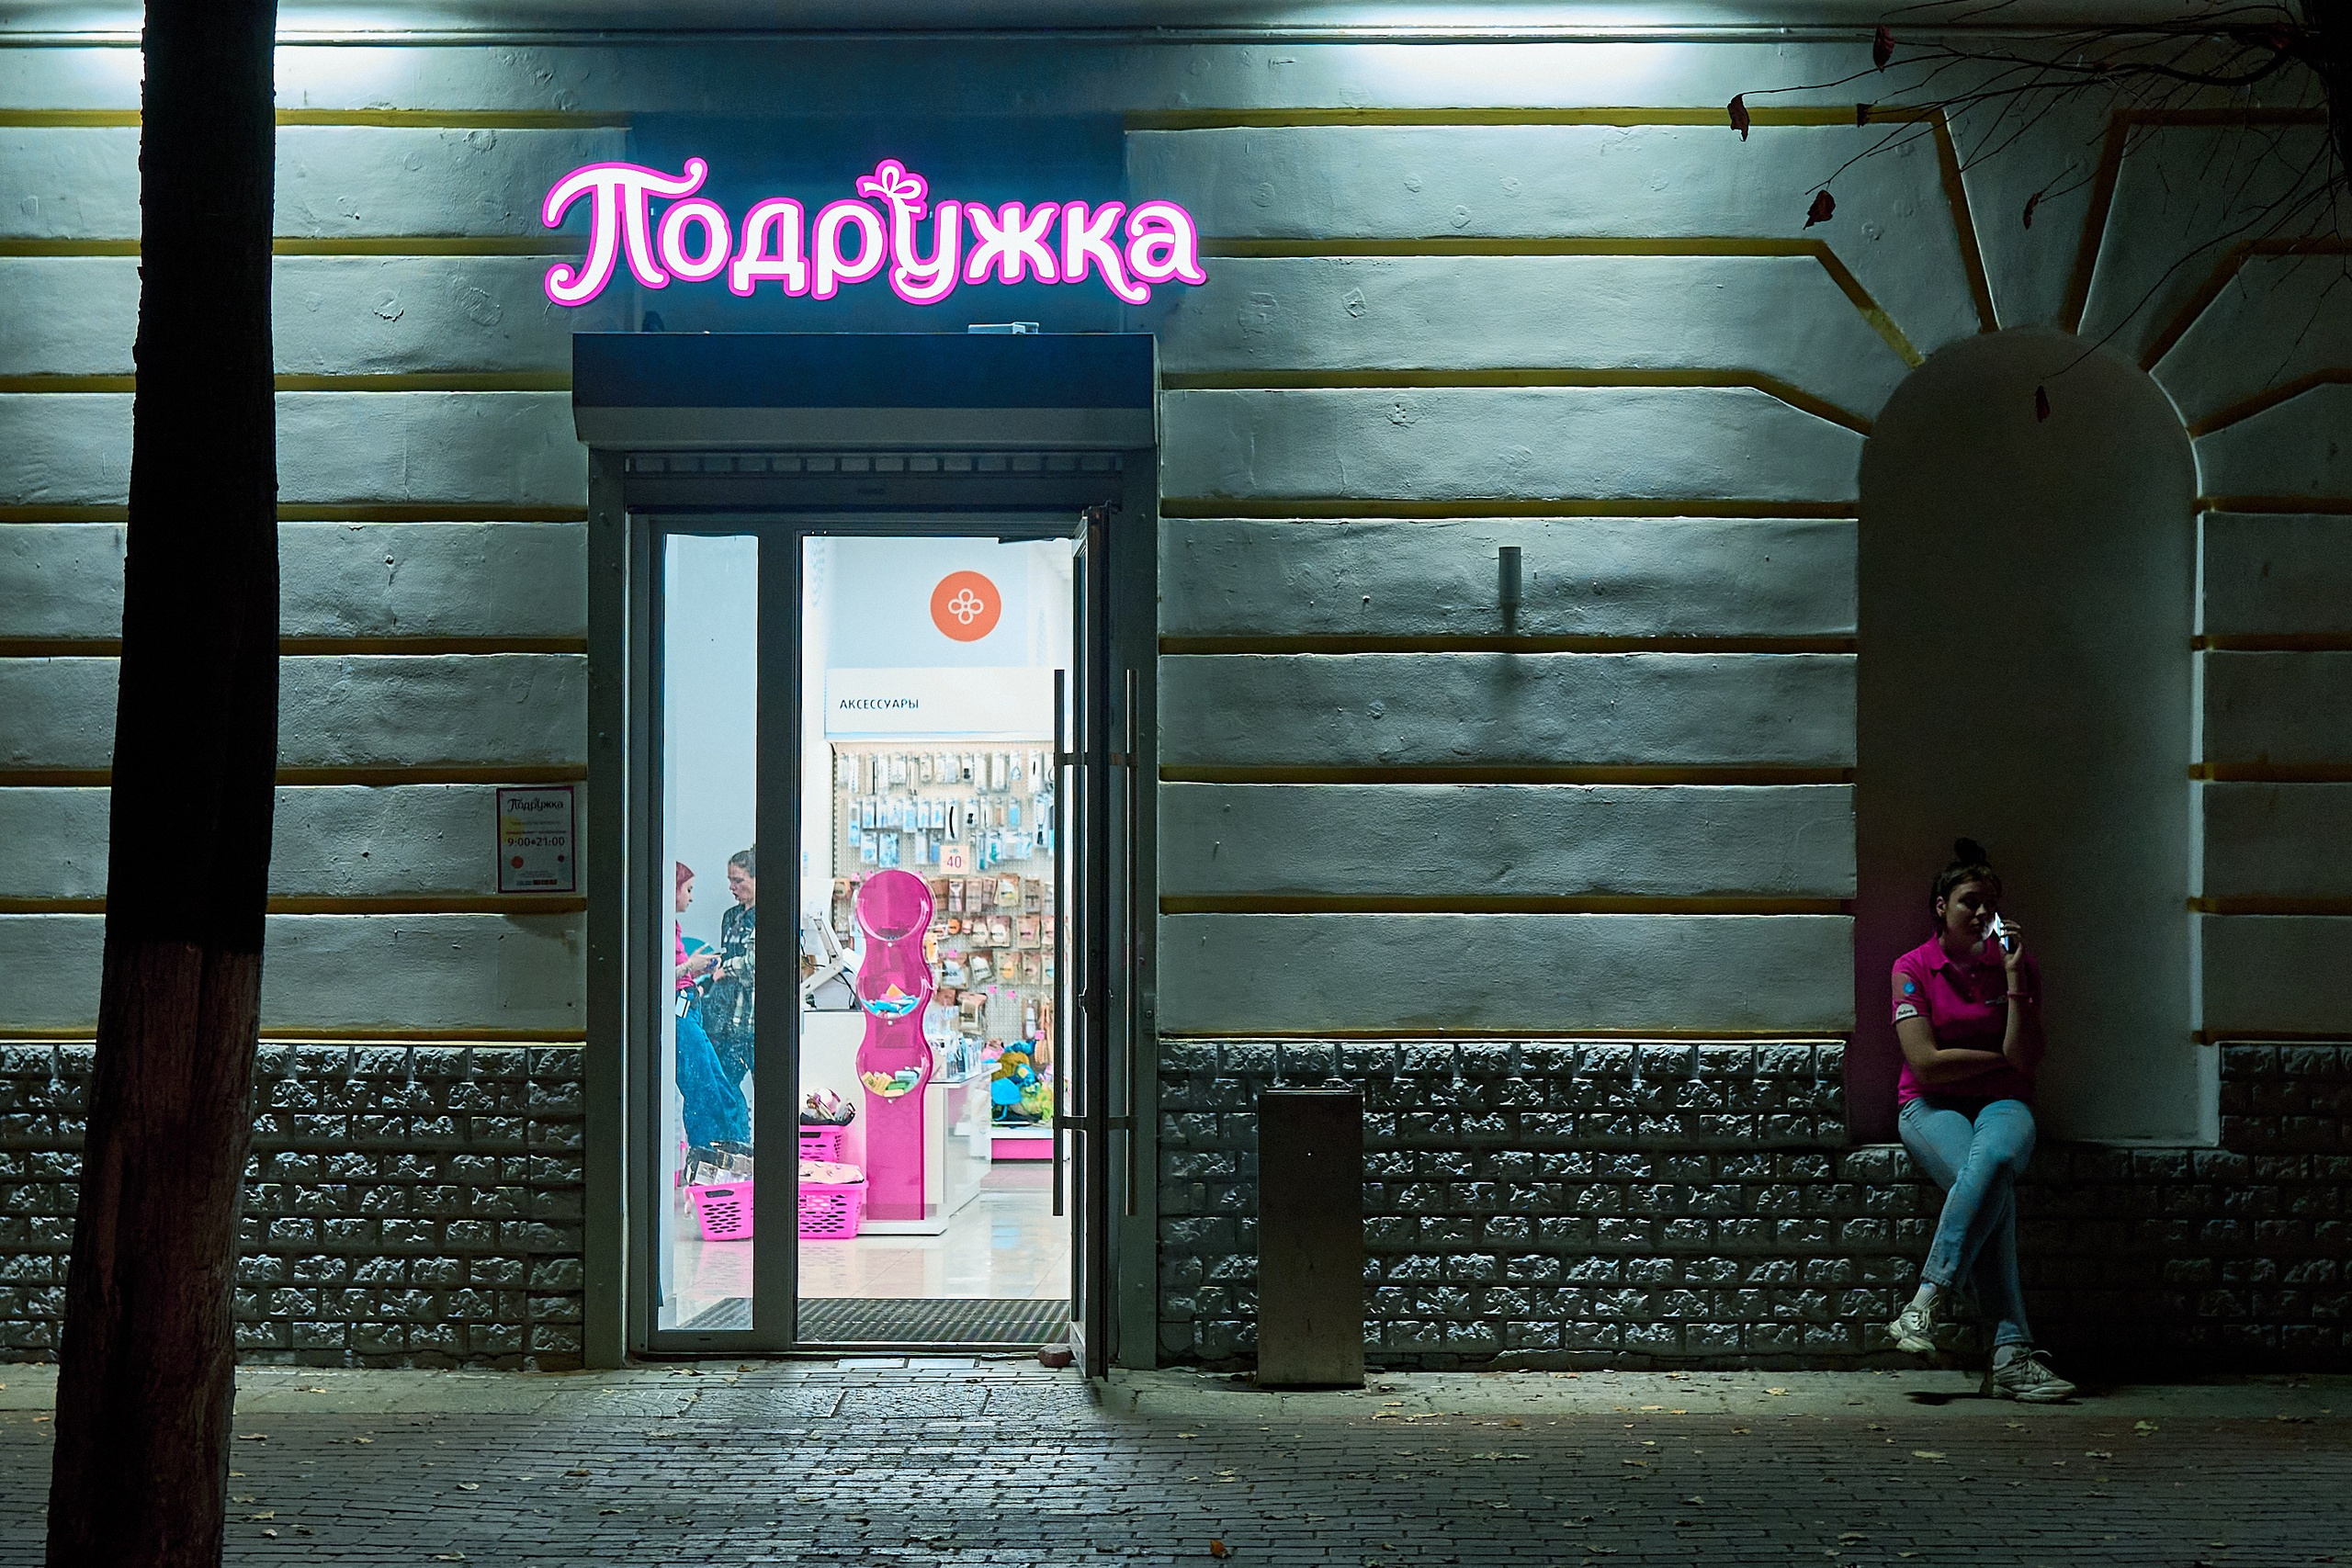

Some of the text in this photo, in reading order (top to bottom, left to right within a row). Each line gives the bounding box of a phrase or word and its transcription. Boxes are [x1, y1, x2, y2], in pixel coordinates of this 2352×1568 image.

[542, 157, 1208, 307] Подружка
[839, 698, 919, 710] АКСЕССУАРЫ
[506, 797, 564, 813] Подружка
[946, 855, 962, 869] 40
